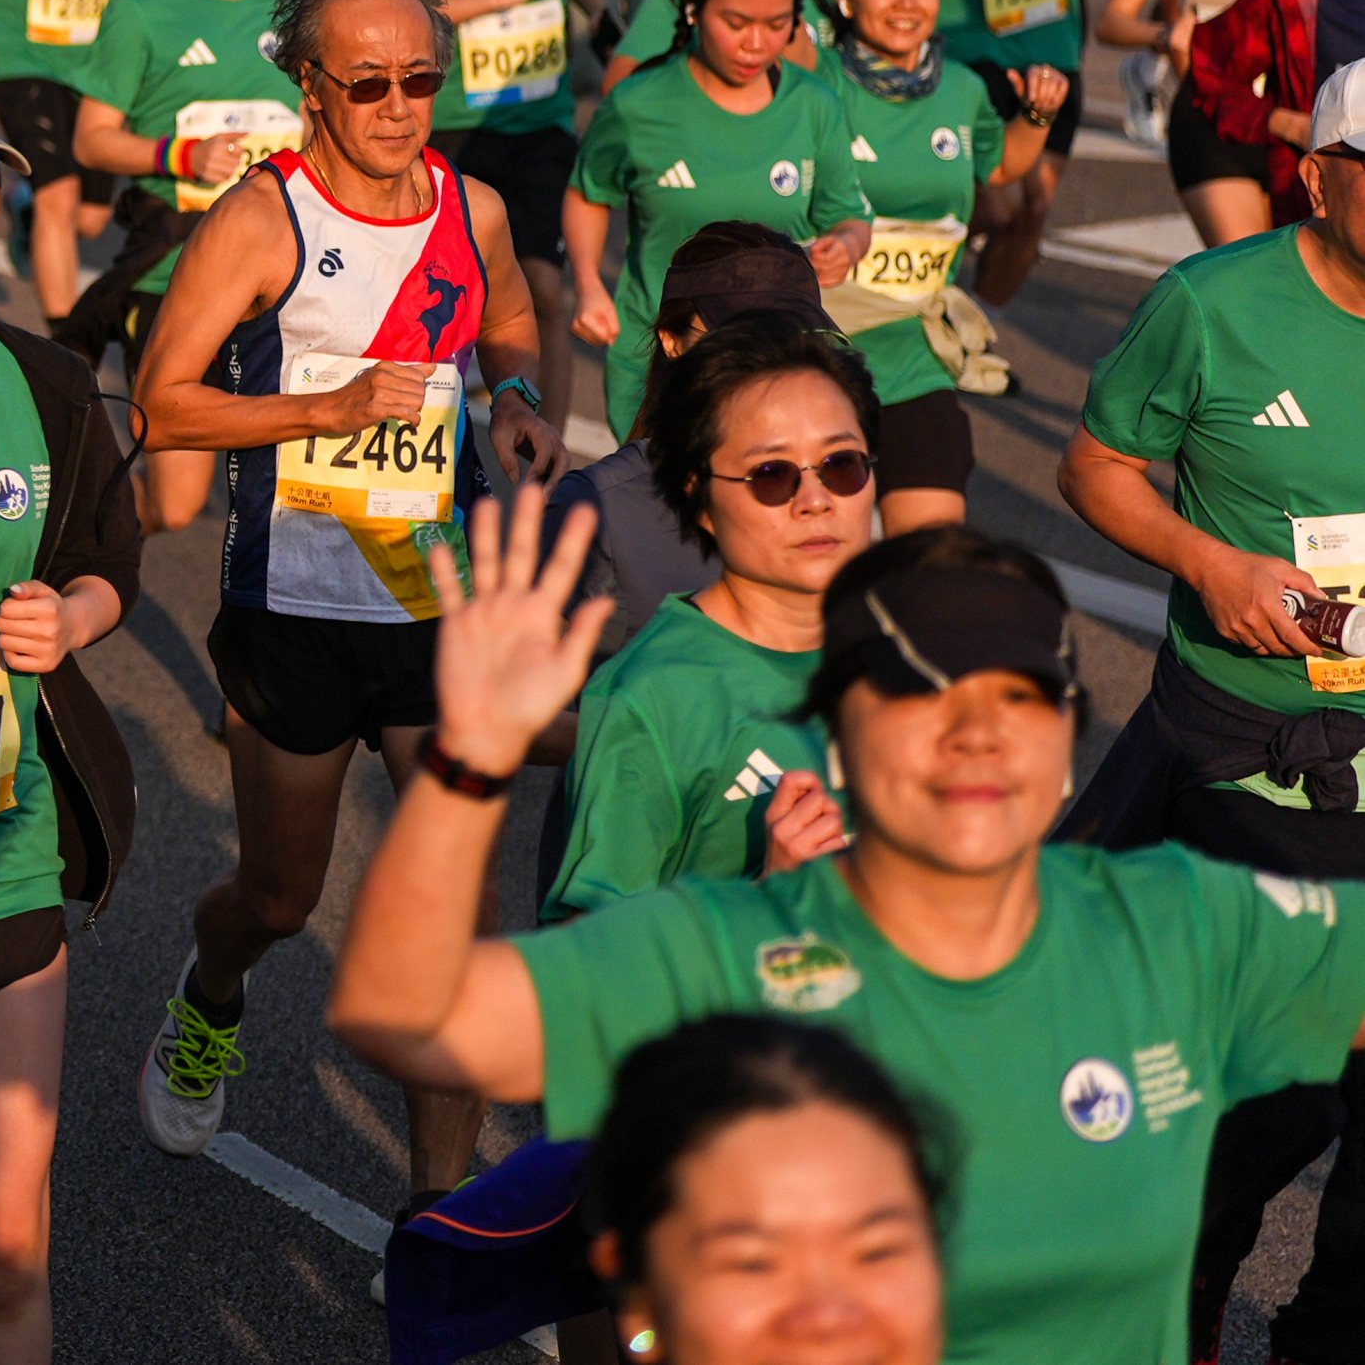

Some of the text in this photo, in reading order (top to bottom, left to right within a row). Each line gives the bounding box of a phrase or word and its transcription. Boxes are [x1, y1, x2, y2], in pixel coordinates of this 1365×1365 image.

[287, 495, 333, 509] 10km Run 7
[1322, 677, 1365, 688] 10km Run
